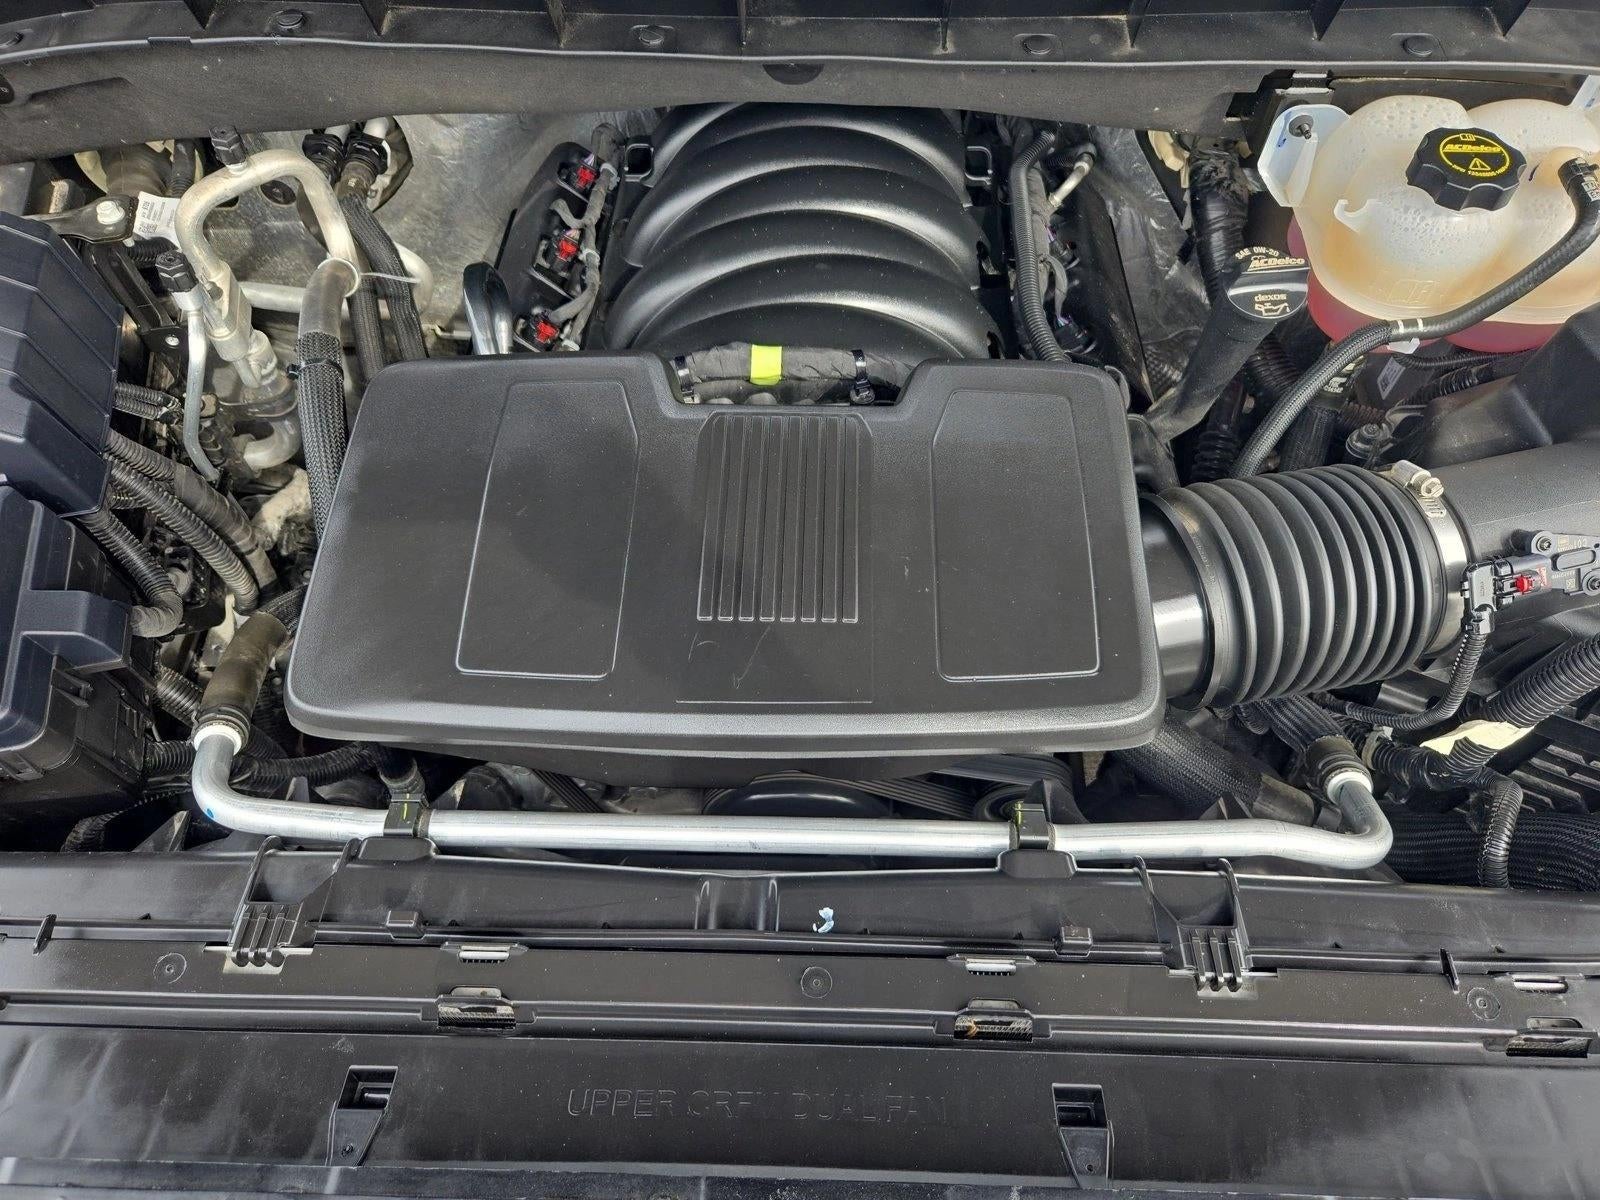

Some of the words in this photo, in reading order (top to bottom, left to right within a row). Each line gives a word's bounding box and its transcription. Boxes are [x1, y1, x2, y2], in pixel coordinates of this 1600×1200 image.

[1444, 143, 1502, 152] ACDelco
[1235, 248, 1251, 259] SAE
[1253, 246, 1280, 257] 0W-20
[1249, 256, 1305, 269] ACDelco
[1254, 293, 1287, 301] dexos
[568, 1088, 678, 1117] UPPER
